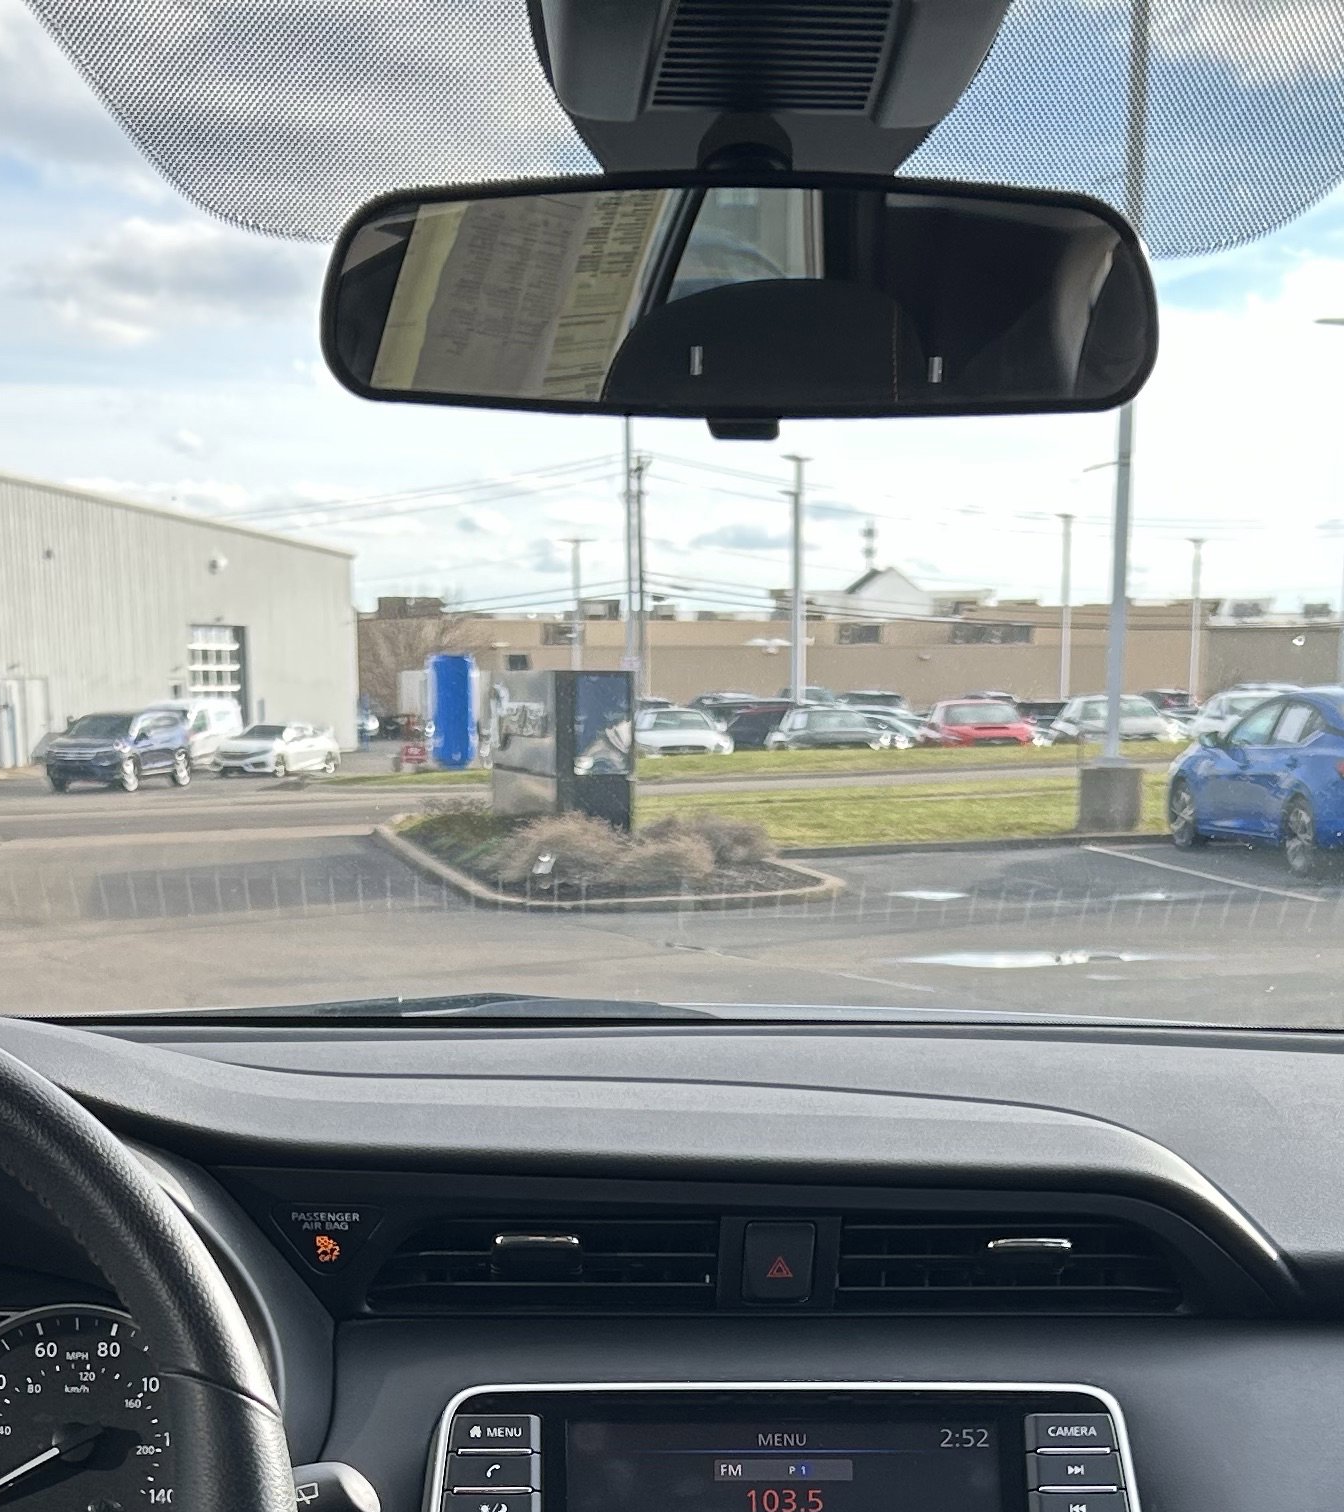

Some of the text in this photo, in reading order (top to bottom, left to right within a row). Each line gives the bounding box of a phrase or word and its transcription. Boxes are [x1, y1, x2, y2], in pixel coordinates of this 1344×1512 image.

[292, 1212, 360, 1222] PASSENGER
[302, 1222, 349, 1230] AIR BAG
[35, 1342, 58, 1358] 60
[97, 1342, 120, 1358] 80
[66, 1352, 89, 1361] MPH
[78, 1372, 96, 1381] 120
[27, 1384, 42, 1393] 80
[64, 1384, 90, 1393] km/h
[142, 1377, 160, 1393] 10
[125, 1399, 142, 1408] 160
[486, 1427, 522, 1438] MENU
[1047, 1426, 1097, 1437] CAMERA
[758, 1433, 807, 1446] MENU
[939, 1429, 990, 1448] 2:52
[136, 1446, 155, 1455] 200
[720, 1464, 743, 1477] FM
